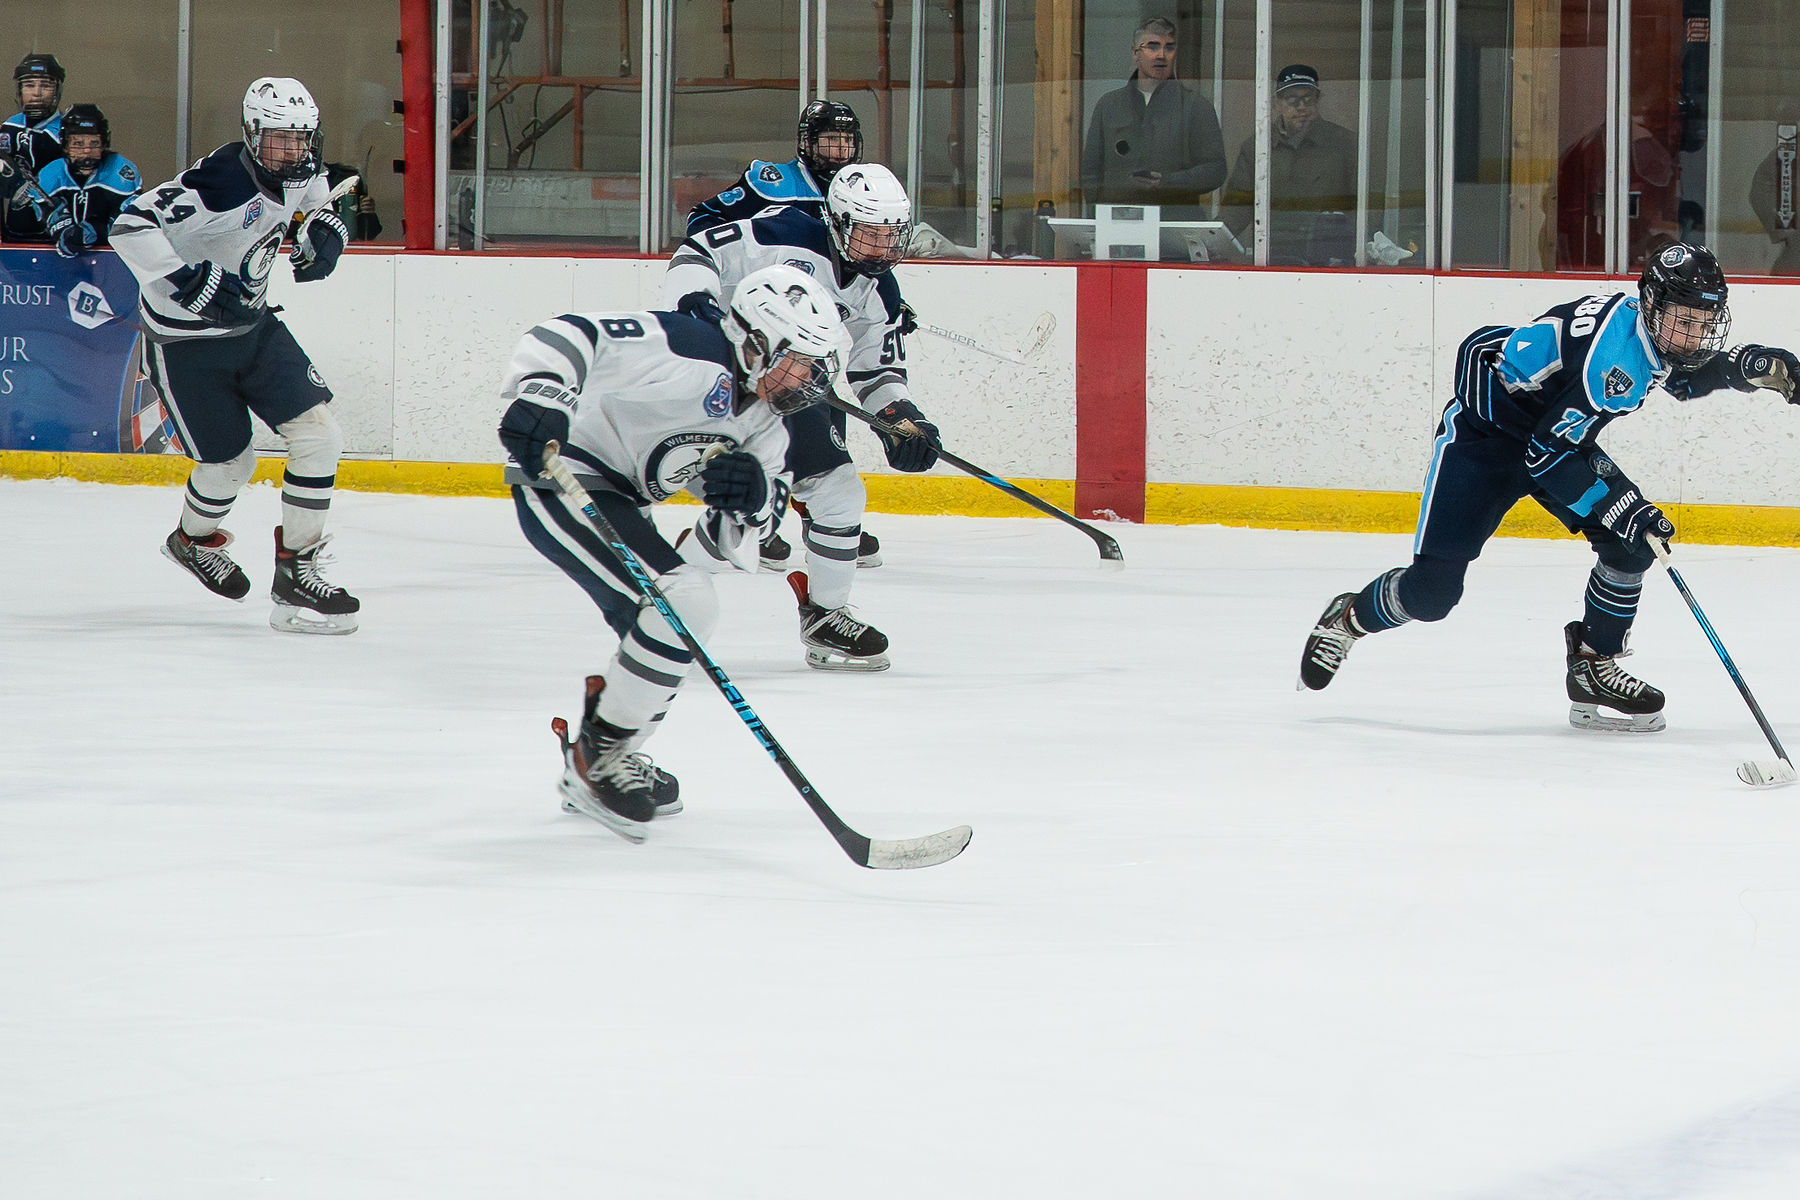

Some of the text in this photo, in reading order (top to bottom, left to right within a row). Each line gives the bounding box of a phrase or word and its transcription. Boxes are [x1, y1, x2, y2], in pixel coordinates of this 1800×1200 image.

[187, 262, 223, 314] WARRIO
[82, 296, 94, 313] B
[664, 433, 720, 449] WILMETTE
